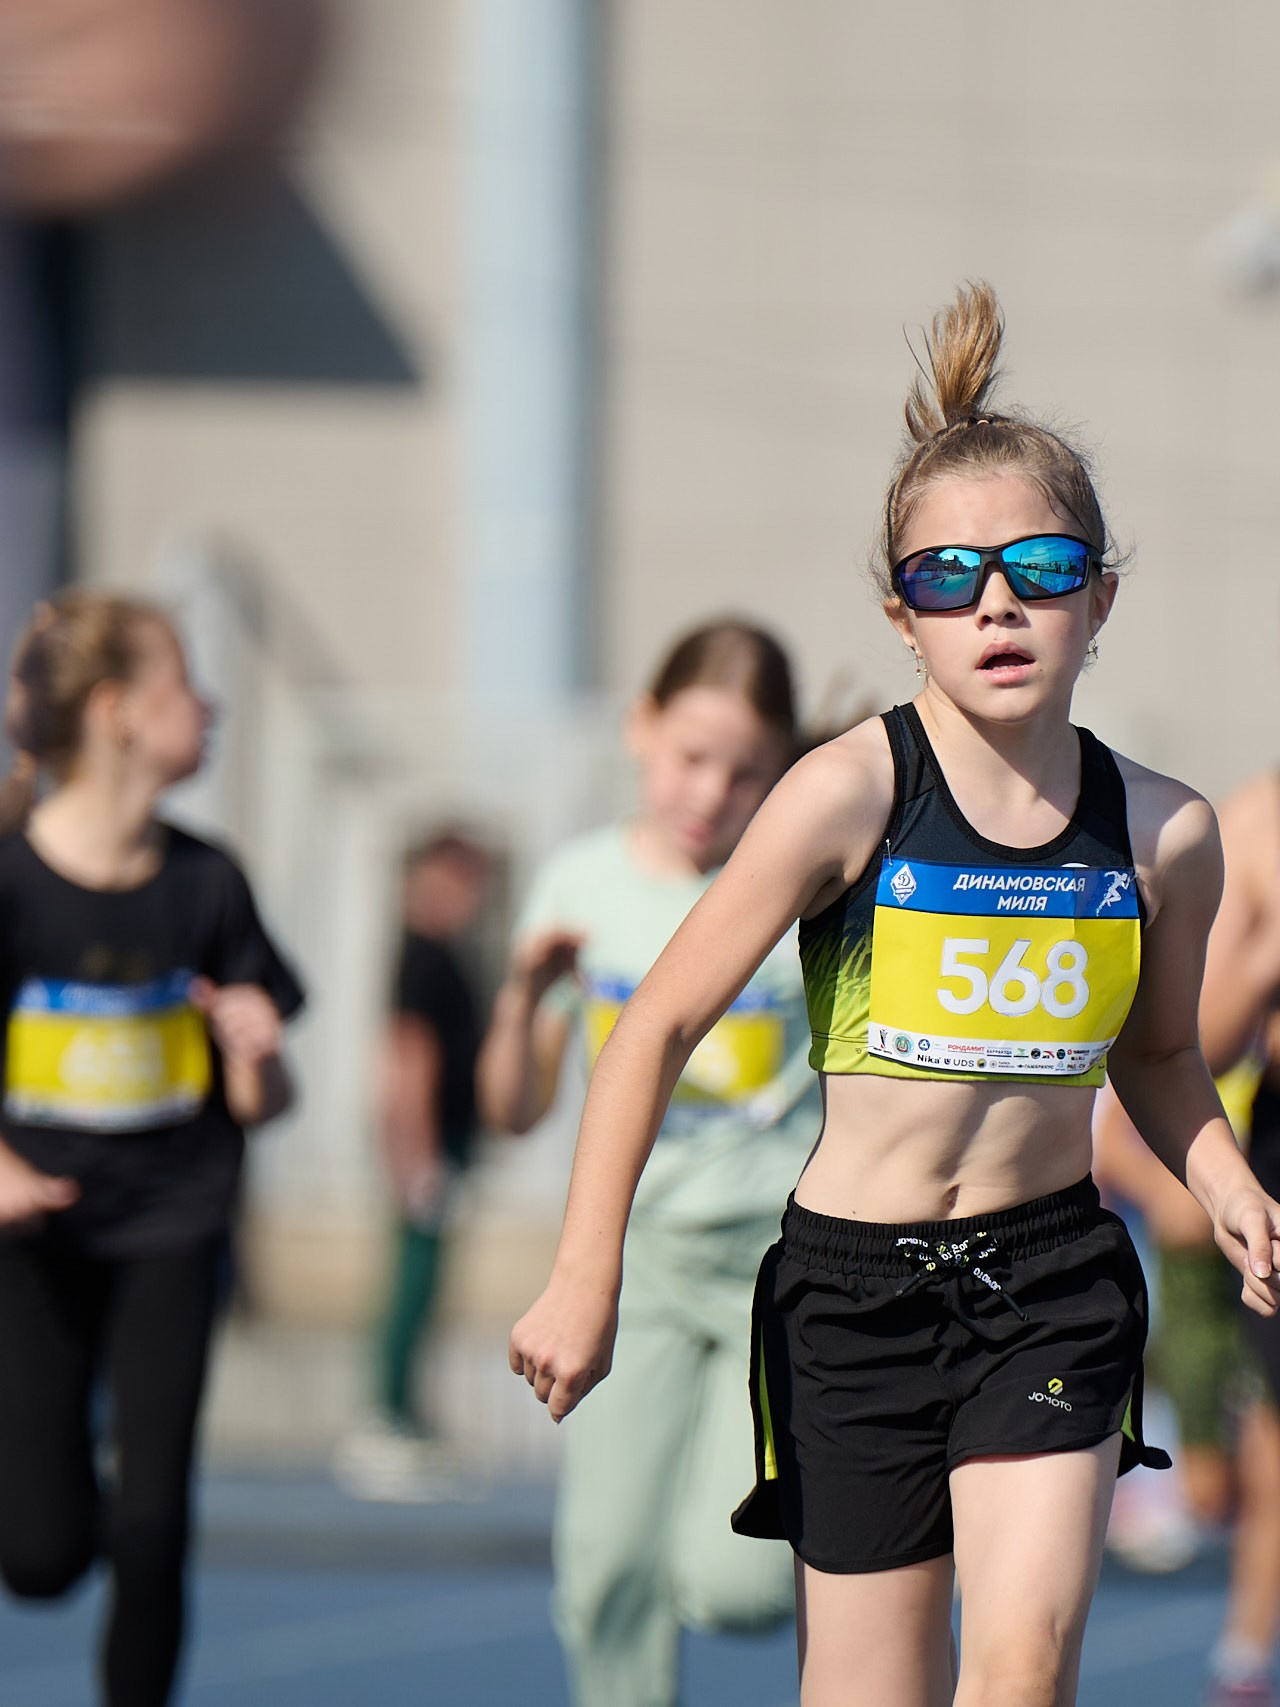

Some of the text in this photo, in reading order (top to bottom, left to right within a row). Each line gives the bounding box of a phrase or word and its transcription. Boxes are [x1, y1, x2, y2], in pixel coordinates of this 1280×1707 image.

[952, 873, 1086, 892] ДИНАМОВСКАЯ
[997, 895, 1048, 911] МИЛЯ
[936, 937, 1090, 1019] 568
[917, 1054, 940, 1065] Nika
[953, 1058, 975, 1068] UDS
